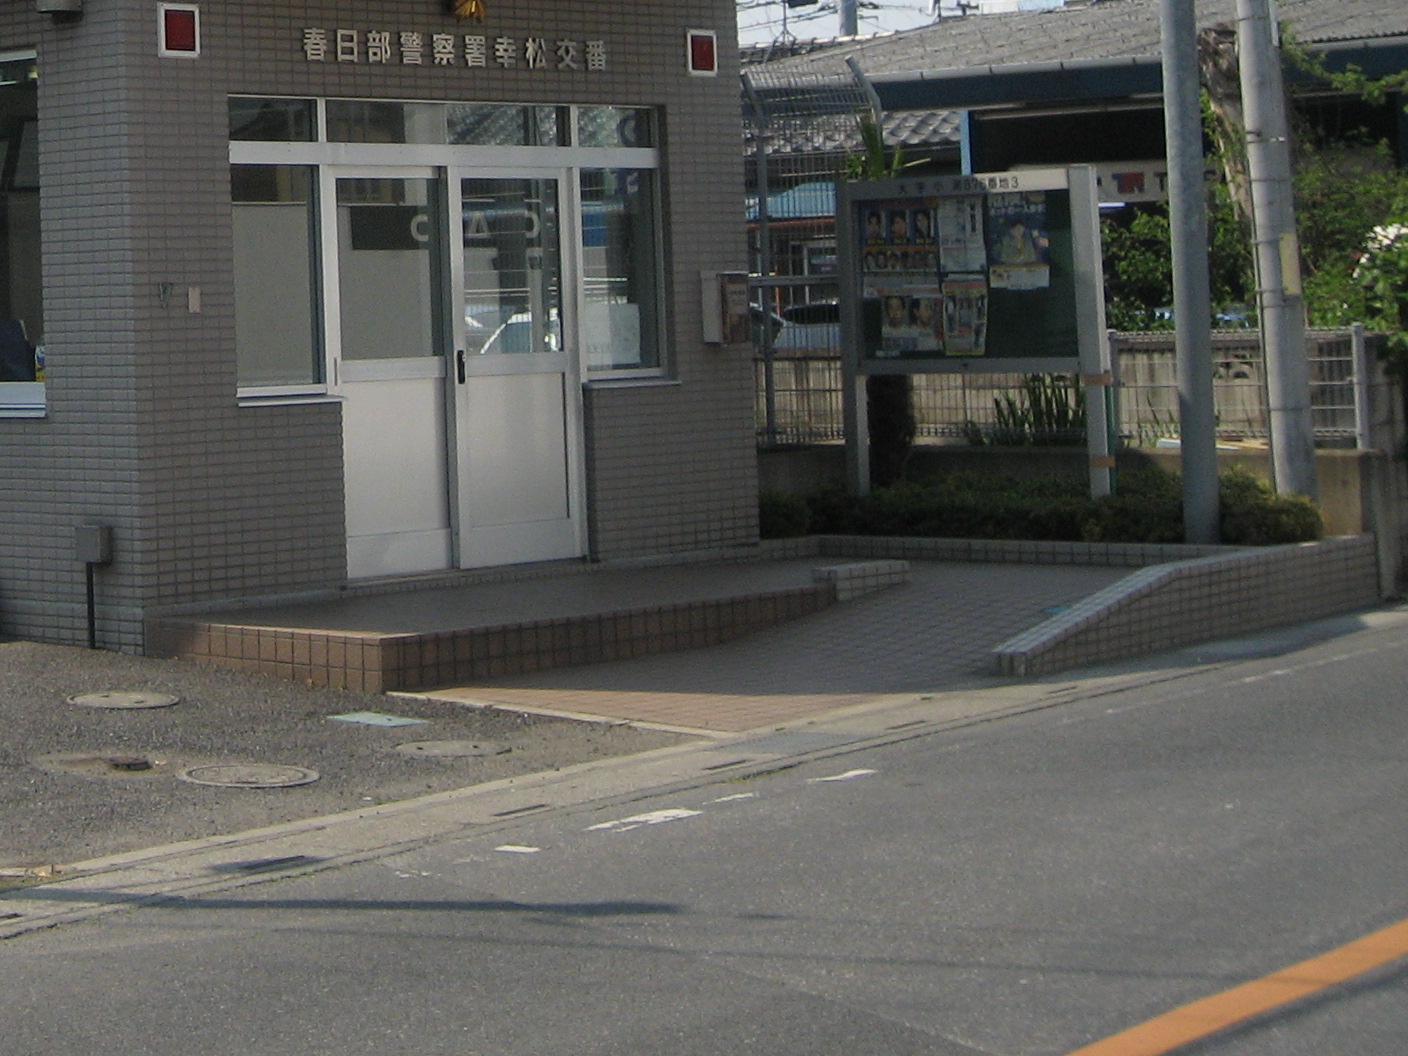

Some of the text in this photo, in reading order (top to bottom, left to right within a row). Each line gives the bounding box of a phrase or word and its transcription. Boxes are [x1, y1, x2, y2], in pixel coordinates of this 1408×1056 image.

[301, 27, 608, 71] 春日部警察署幸松交番
